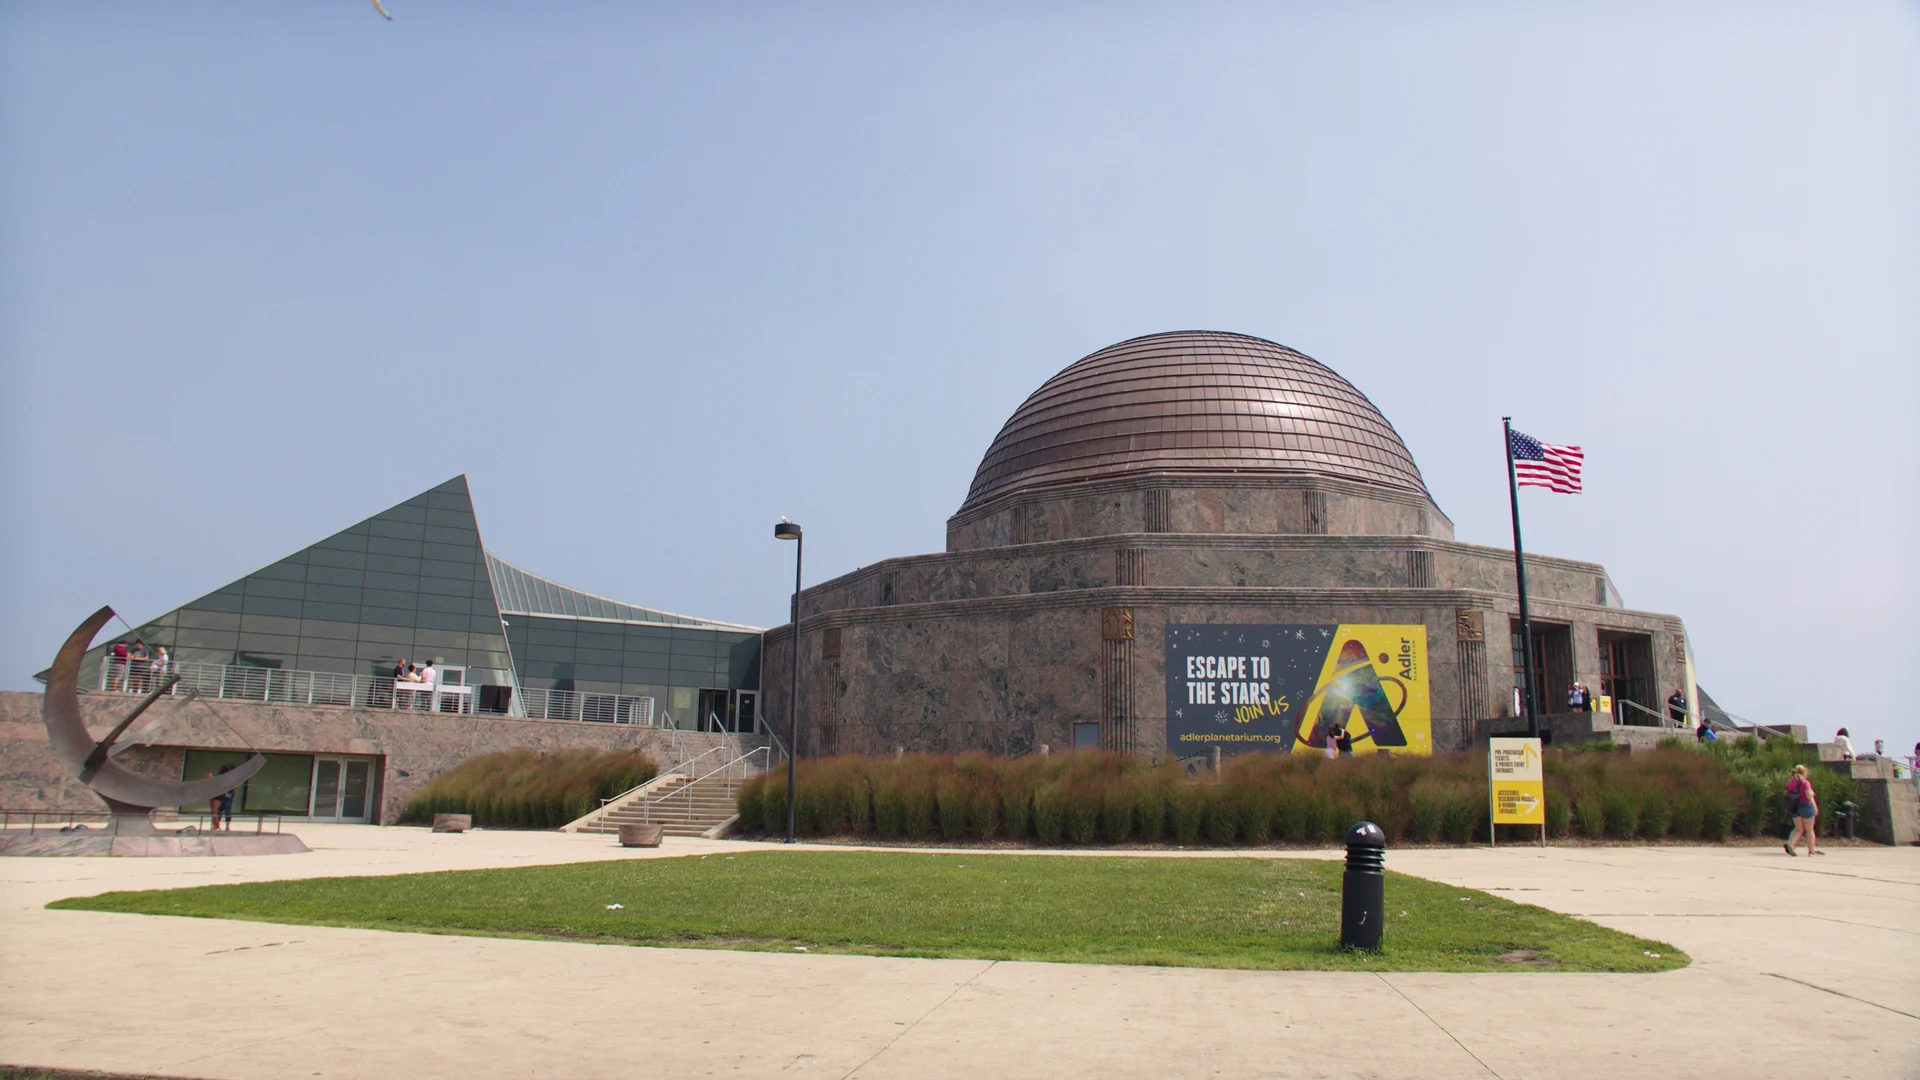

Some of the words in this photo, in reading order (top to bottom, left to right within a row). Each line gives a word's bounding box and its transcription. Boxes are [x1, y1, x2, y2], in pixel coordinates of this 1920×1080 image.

[1186, 656, 1247, 678] ESCAPE
[1251, 656, 1270, 679] TO
[1398, 637, 1411, 680] Adler
[1187, 682, 1216, 704] THE
[1220, 682, 1270, 705] STARS
[1234, 701, 1264, 723] JOIN
[1267, 696, 1289, 715] US
[1180, 733, 1281, 743] adlerplanetarium.org
